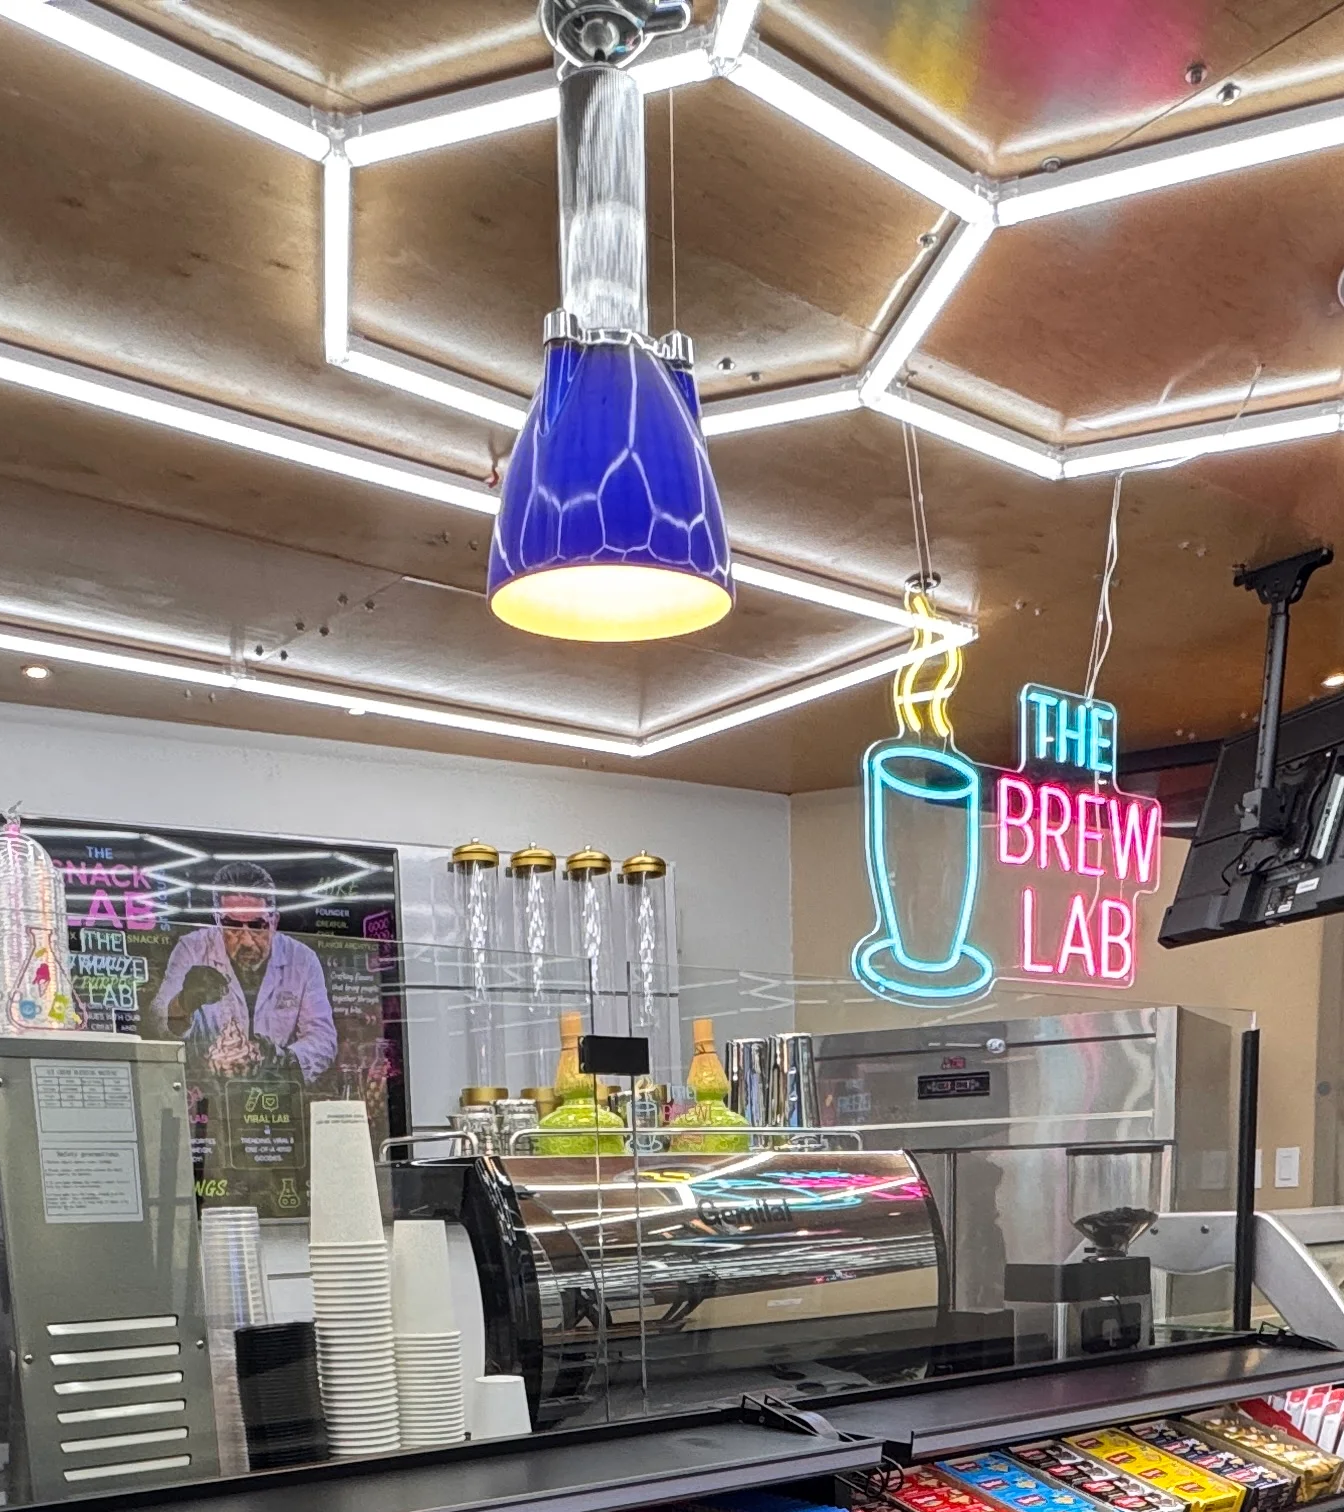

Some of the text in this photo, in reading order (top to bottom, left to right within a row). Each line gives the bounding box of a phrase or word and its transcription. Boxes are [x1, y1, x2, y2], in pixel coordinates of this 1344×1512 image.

[1028, 690, 1116, 774] THE
[85, 846, 113, 860] THE
[997, 776, 1158, 885] BREW
[83, 929, 124, 952] THE
[1021, 887, 1135, 981] LAB
[88, 983, 135, 1008] LAB
